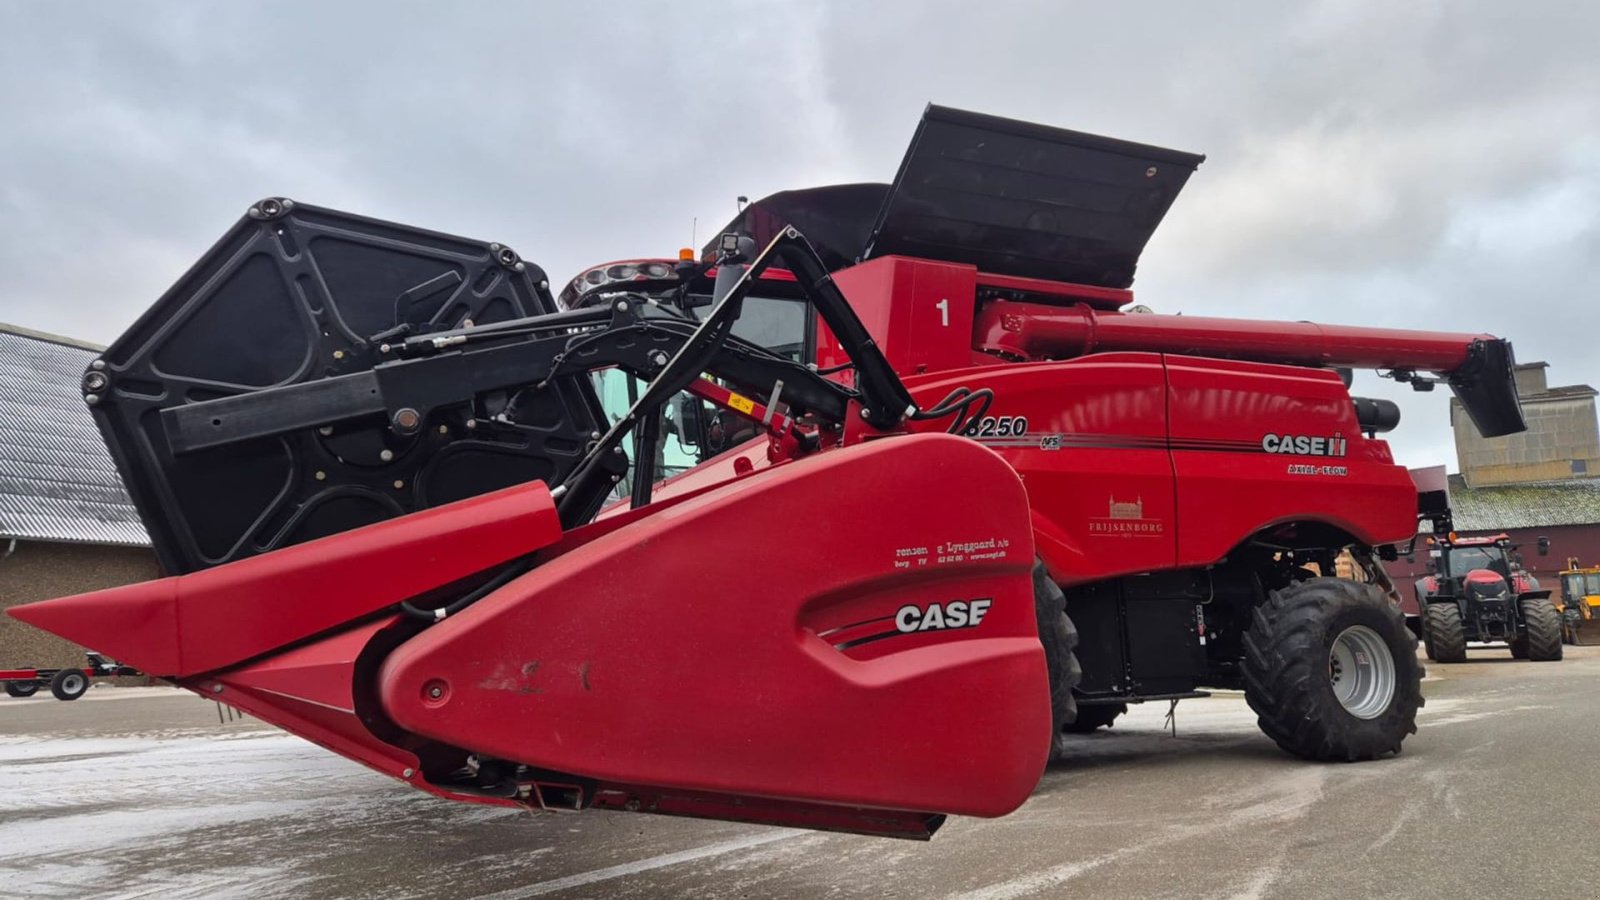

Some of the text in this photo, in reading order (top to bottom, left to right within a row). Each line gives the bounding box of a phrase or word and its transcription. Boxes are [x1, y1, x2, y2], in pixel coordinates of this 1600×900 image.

[936, 299, 948, 326] 1
[1262, 433, 1325, 455] CASE
[1088, 522, 1163, 533] FRIJSENBORG
[895, 600, 991, 633] CASE
